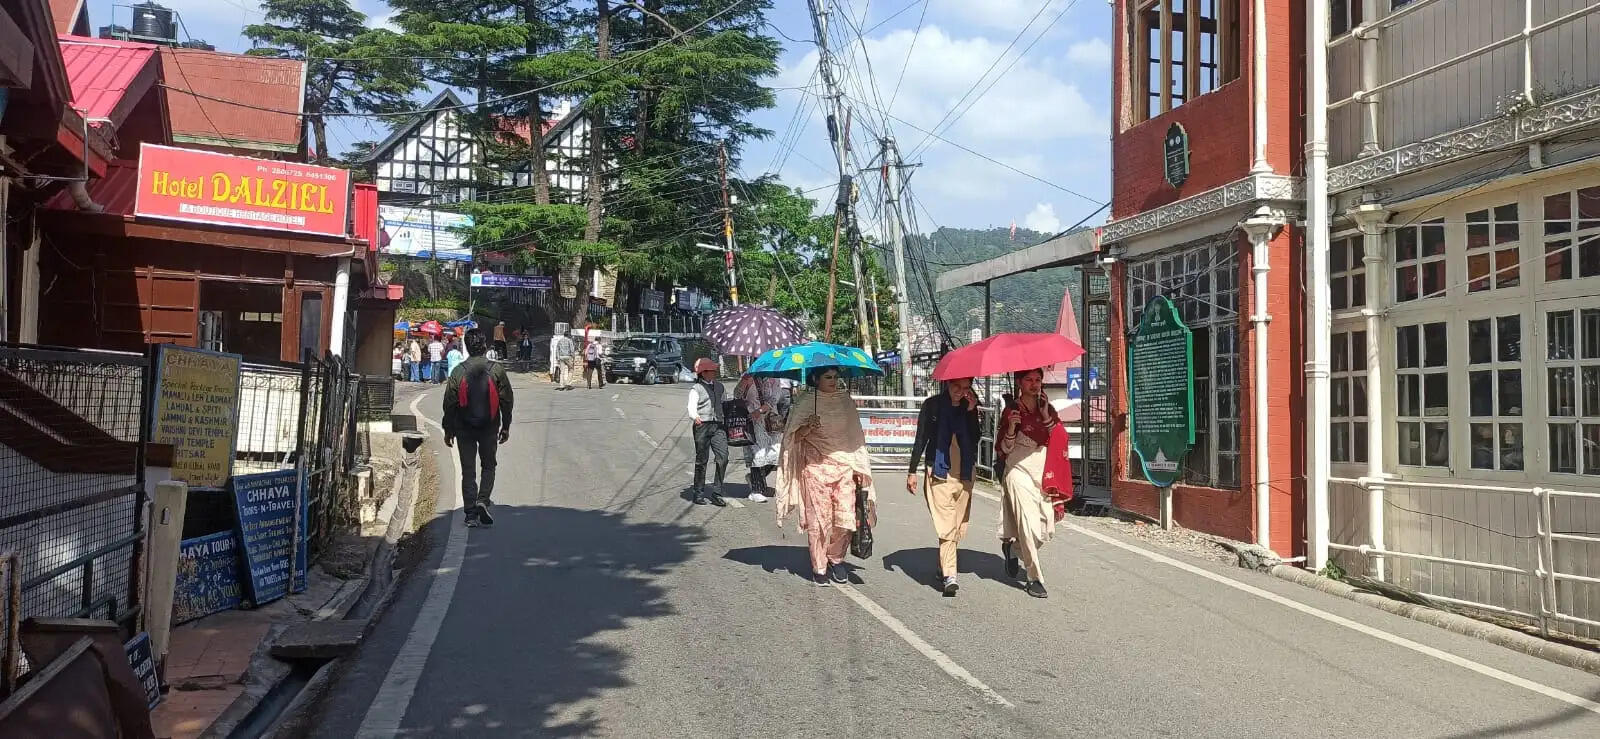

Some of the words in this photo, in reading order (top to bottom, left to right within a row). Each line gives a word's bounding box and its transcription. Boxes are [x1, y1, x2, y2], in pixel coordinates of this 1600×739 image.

[152, 170, 203, 200] Hotel
[211, 171, 334, 215] DALZIEL
[202, 406, 222, 416] SPITI
[161, 412, 188, 424] JAMMU
[195, 416, 228, 427] KASHMIR
[205, 428, 230, 438] TEMPLE
[187, 439, 215, 449] TEMPLE
[247, 485, 290, 503] CHHAYA
[180, 543, 210, 560] HAYA
